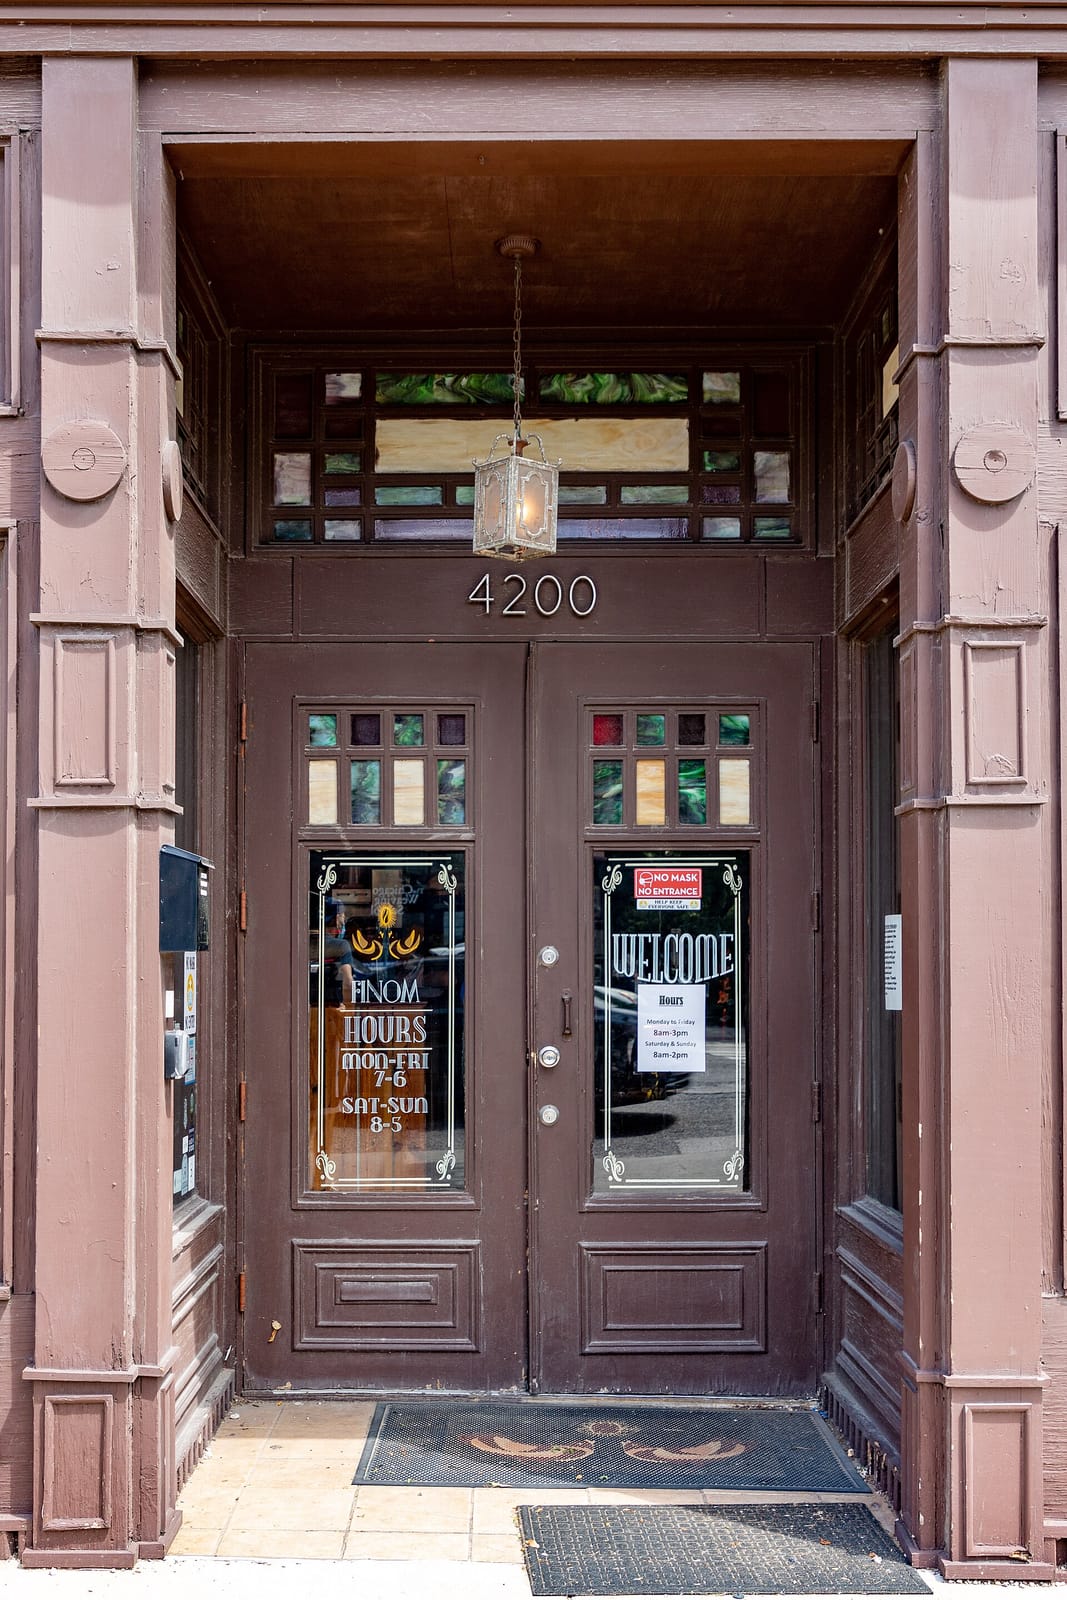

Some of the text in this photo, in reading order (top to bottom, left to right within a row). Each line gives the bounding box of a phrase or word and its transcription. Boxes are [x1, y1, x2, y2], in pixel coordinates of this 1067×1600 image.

[468, 573, 597, 616] 4200
[653, 873, 698, 882] NO MASK
[638, 887, 698, 896] NO ENTRANCE
[612, 933, 734, 984] WELCOME
[351, 978, 421, 1004] FINOM
[659, 995, 684, 1006] Hours
[343, 1015, 427, 1044] HOURS
[653, 1029, 689, 1038] 8am-3pm
[341, 1052, 430, 1070] MON-FRI
[653, 1051, 689, 1060] 8am-2pm
[373, 1070, 407, 1088] 7-6
[342, 1097, 429, 1114] SAT-SUN
[369, 1116, 402, 1133] 8-5
